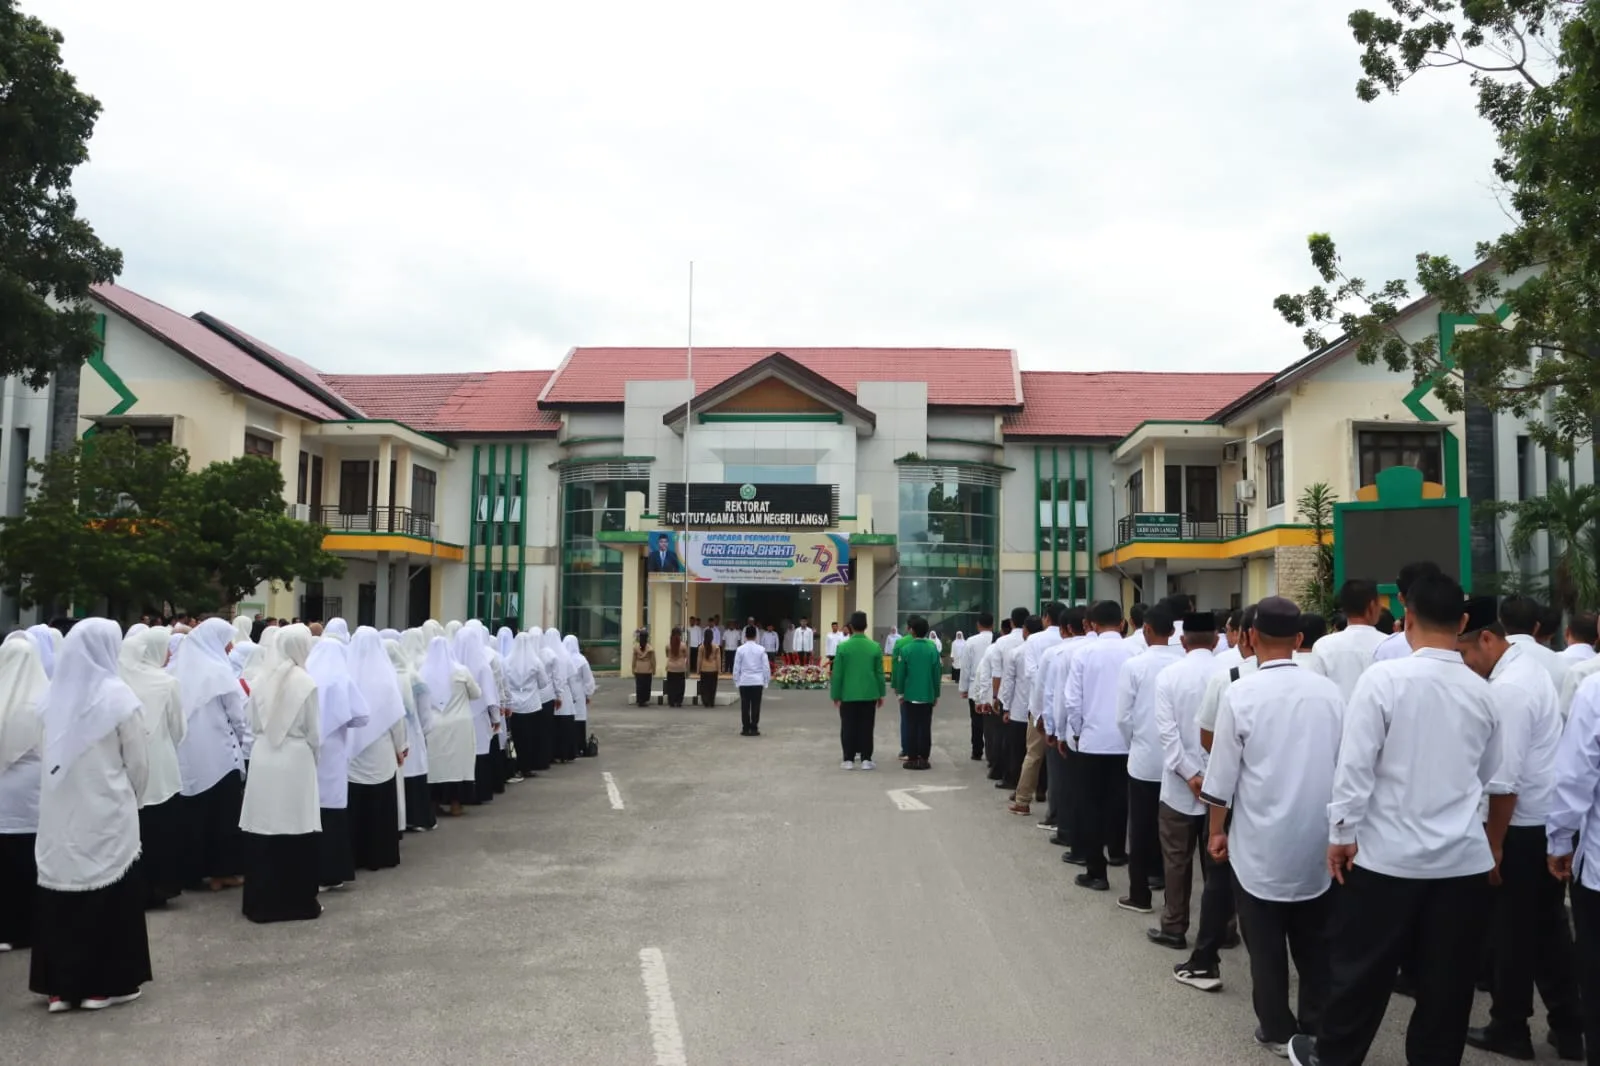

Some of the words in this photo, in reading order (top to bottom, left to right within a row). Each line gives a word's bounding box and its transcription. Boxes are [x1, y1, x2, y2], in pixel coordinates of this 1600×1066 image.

[725, 501, 770, 512] REKTORAT
[667, 512, 704, 524] INSTTUT
[705, 512, 735, 524] AGAMA
[736, 513, 762, 524] ISLAM
[764, 513, 793, 524] NEGERI
[795, 514, 829, 525] LANGSA
[702, 543, 726, 556] HARI
[727, 543, 755, 556] AMAL
